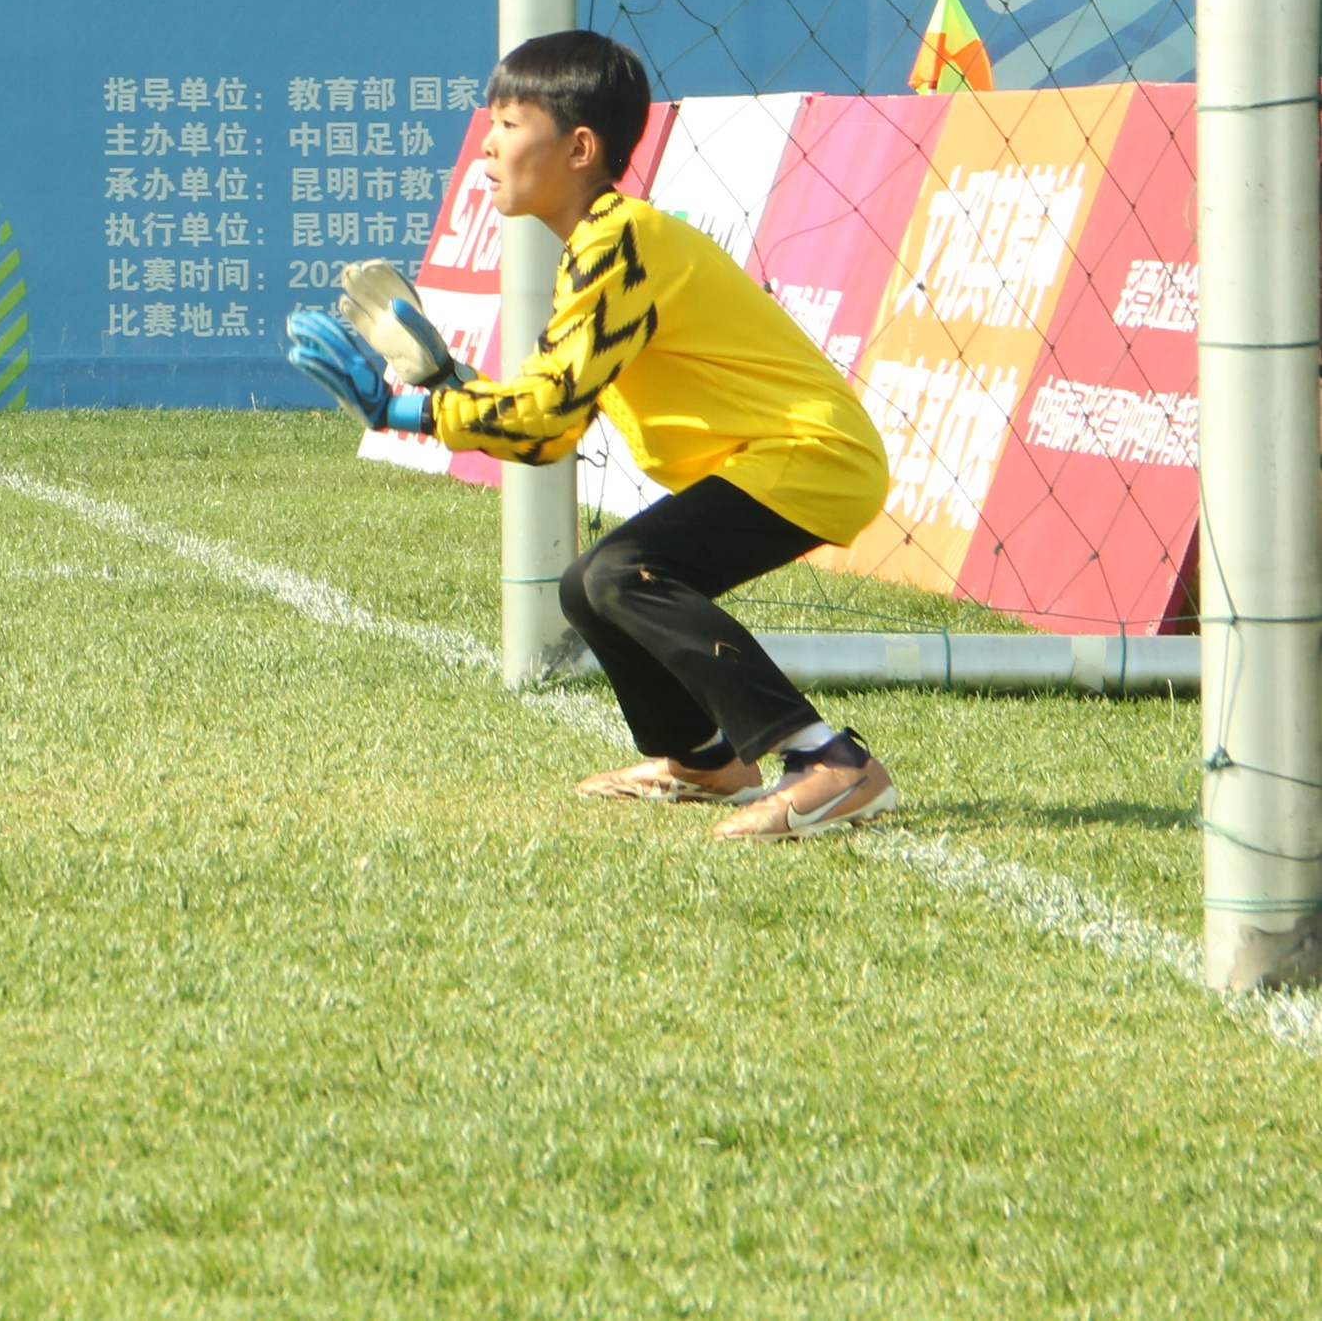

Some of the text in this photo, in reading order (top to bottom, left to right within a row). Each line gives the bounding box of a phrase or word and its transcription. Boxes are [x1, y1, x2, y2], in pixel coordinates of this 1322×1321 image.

[103, 76, 489, 112] 指导单位： 教育部 国家
[103, 121, 435, 157] 主办单位： 中国足协
[104, 166, 264, 202] 承办单位：
[104, 211, 265, 247] 执行单位：
[107, 257, 265, 292] 比赛时间：
[1112, 259, 1199, 333] 彩票公益金
[108, 302, 266, 338] 比赛地点：
[1024, 374, 1199, 468] 中国福利彩票和中国体育彩
